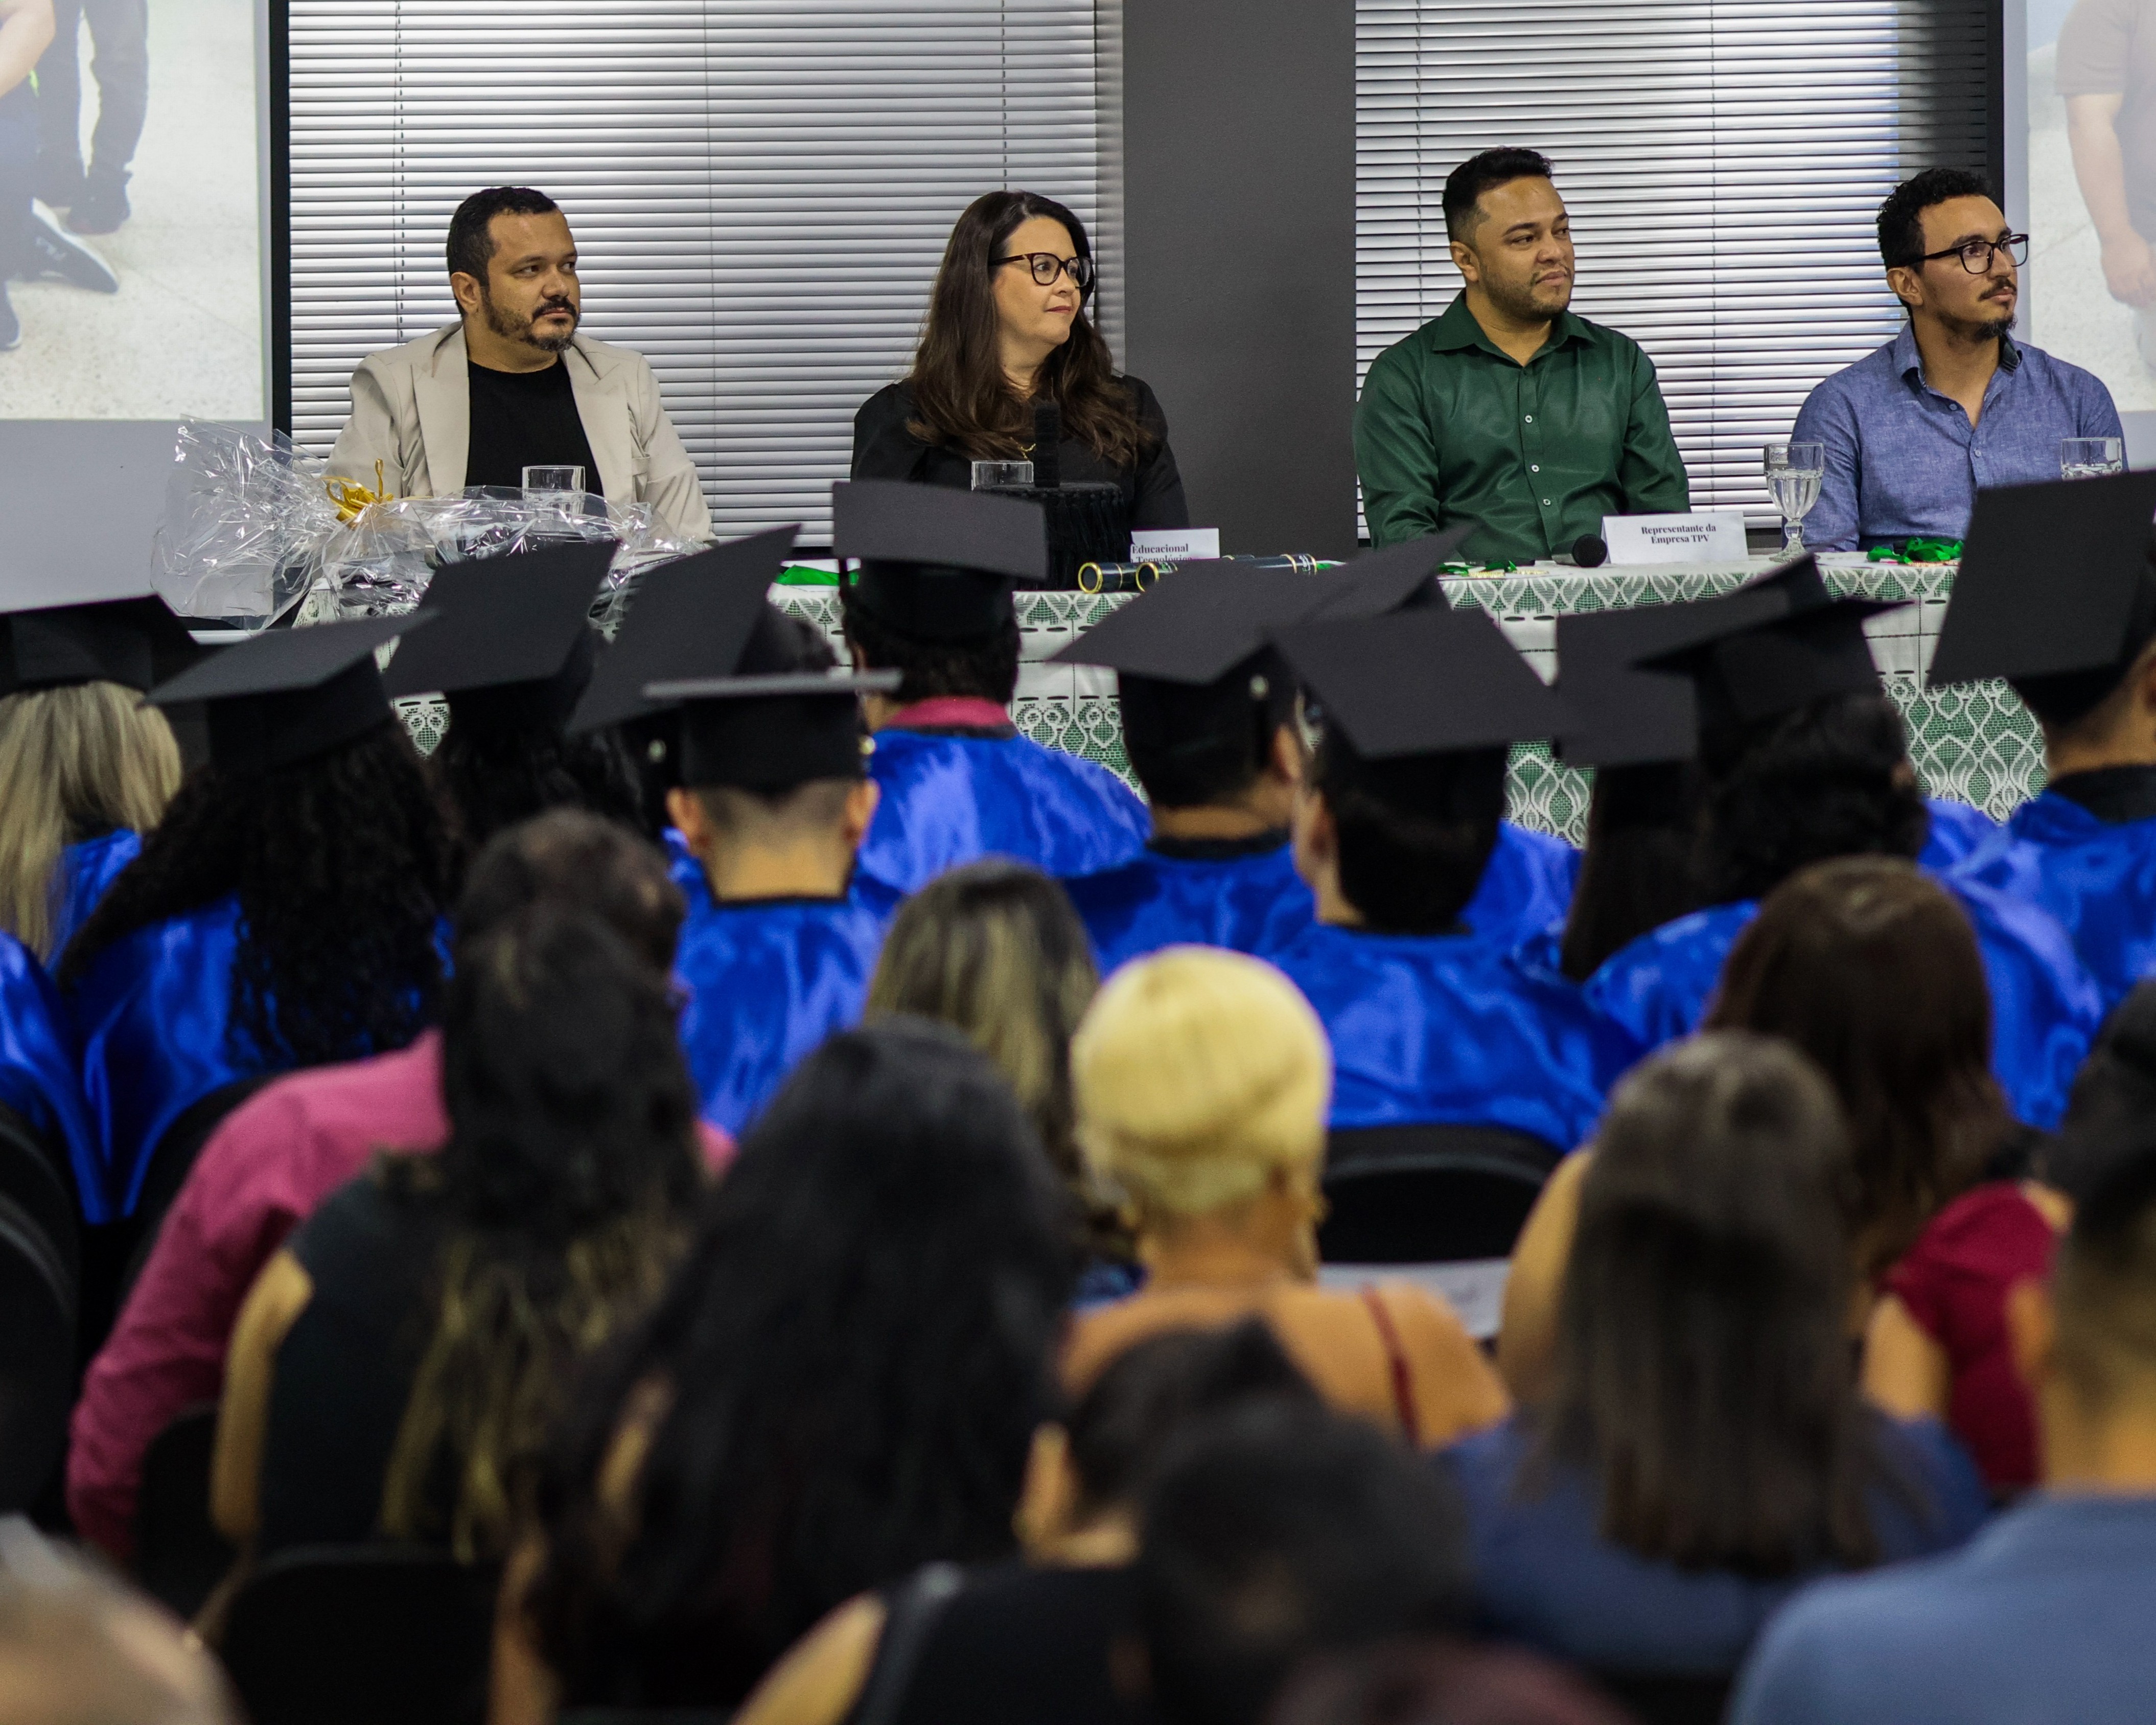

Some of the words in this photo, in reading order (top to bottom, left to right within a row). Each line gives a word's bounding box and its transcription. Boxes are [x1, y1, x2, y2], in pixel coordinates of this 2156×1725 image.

[1641, 525, 1704, 535] Representante
[1706, 523, 1716, 532] da
[1651, 536, 1689, 545] Empresa
[1690, 534, 1709, 542] TPV
[1132, 543, 1188, 554] Educacional
